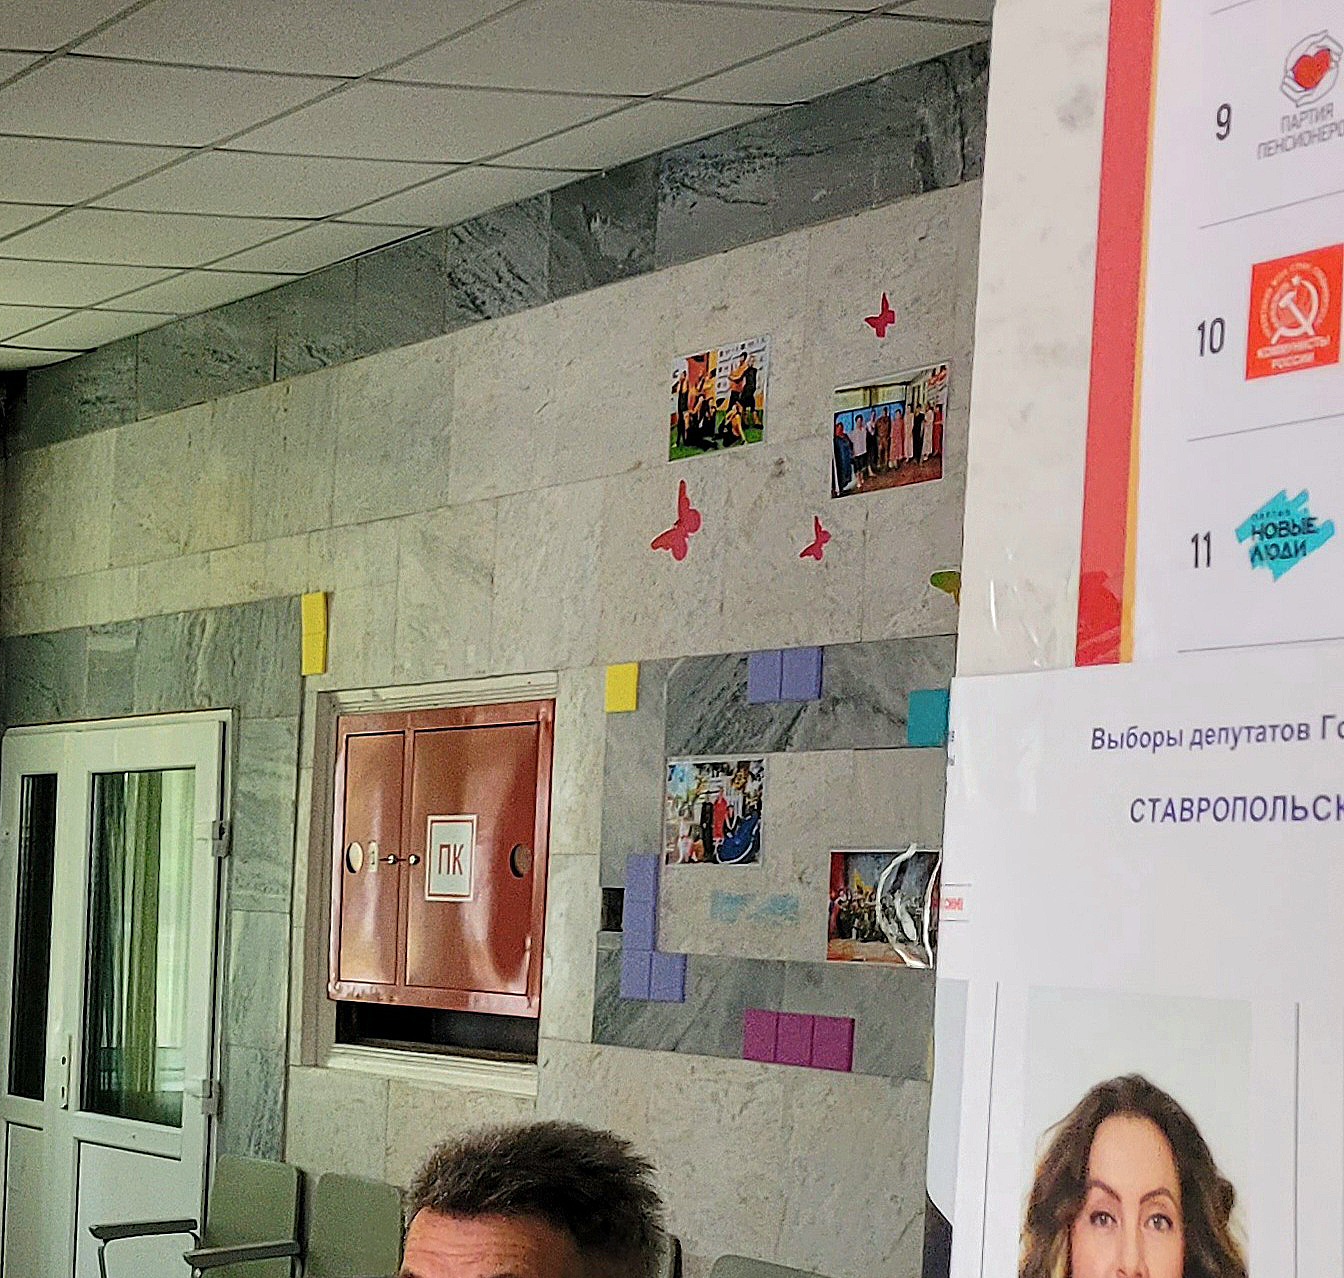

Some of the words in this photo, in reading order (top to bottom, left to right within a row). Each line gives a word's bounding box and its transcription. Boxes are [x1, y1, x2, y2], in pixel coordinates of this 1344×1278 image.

[1216, 103, 1231, 140] 9
[1281, 102, 1333, 133] ПАРТИЯ
[1196, 317, 1225, 357] 10
[1251, 517, 1318, 541] НОВЫЕ
[1191, 531, 1211, 568] 11
[1250, 540, 1307, 564] ЛЮДИ
[1090, 726, 1183, 754] Выборы
[1189, 720, 1310, 751] депутатов
[438, 843, 464, 876] ПК
